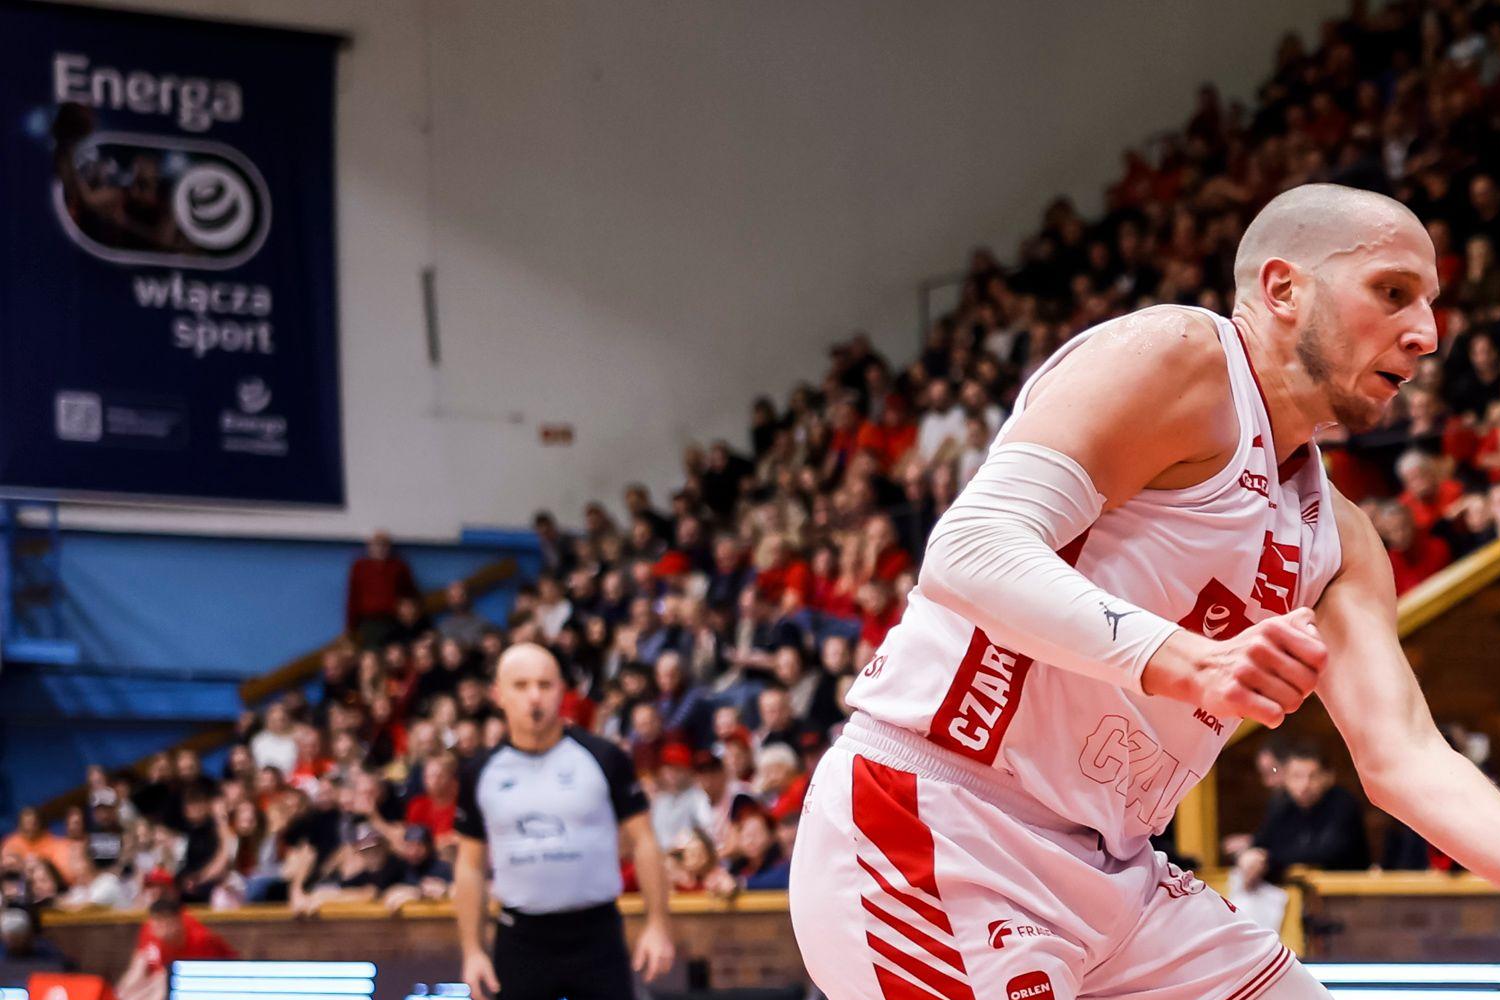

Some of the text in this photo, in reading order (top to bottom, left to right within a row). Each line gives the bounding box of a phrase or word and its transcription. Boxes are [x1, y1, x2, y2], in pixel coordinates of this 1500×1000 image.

[53, 52, 243, 131] Energa
[133, 272, 272, 316] włącza
[171, 317, 273, 358] sport
